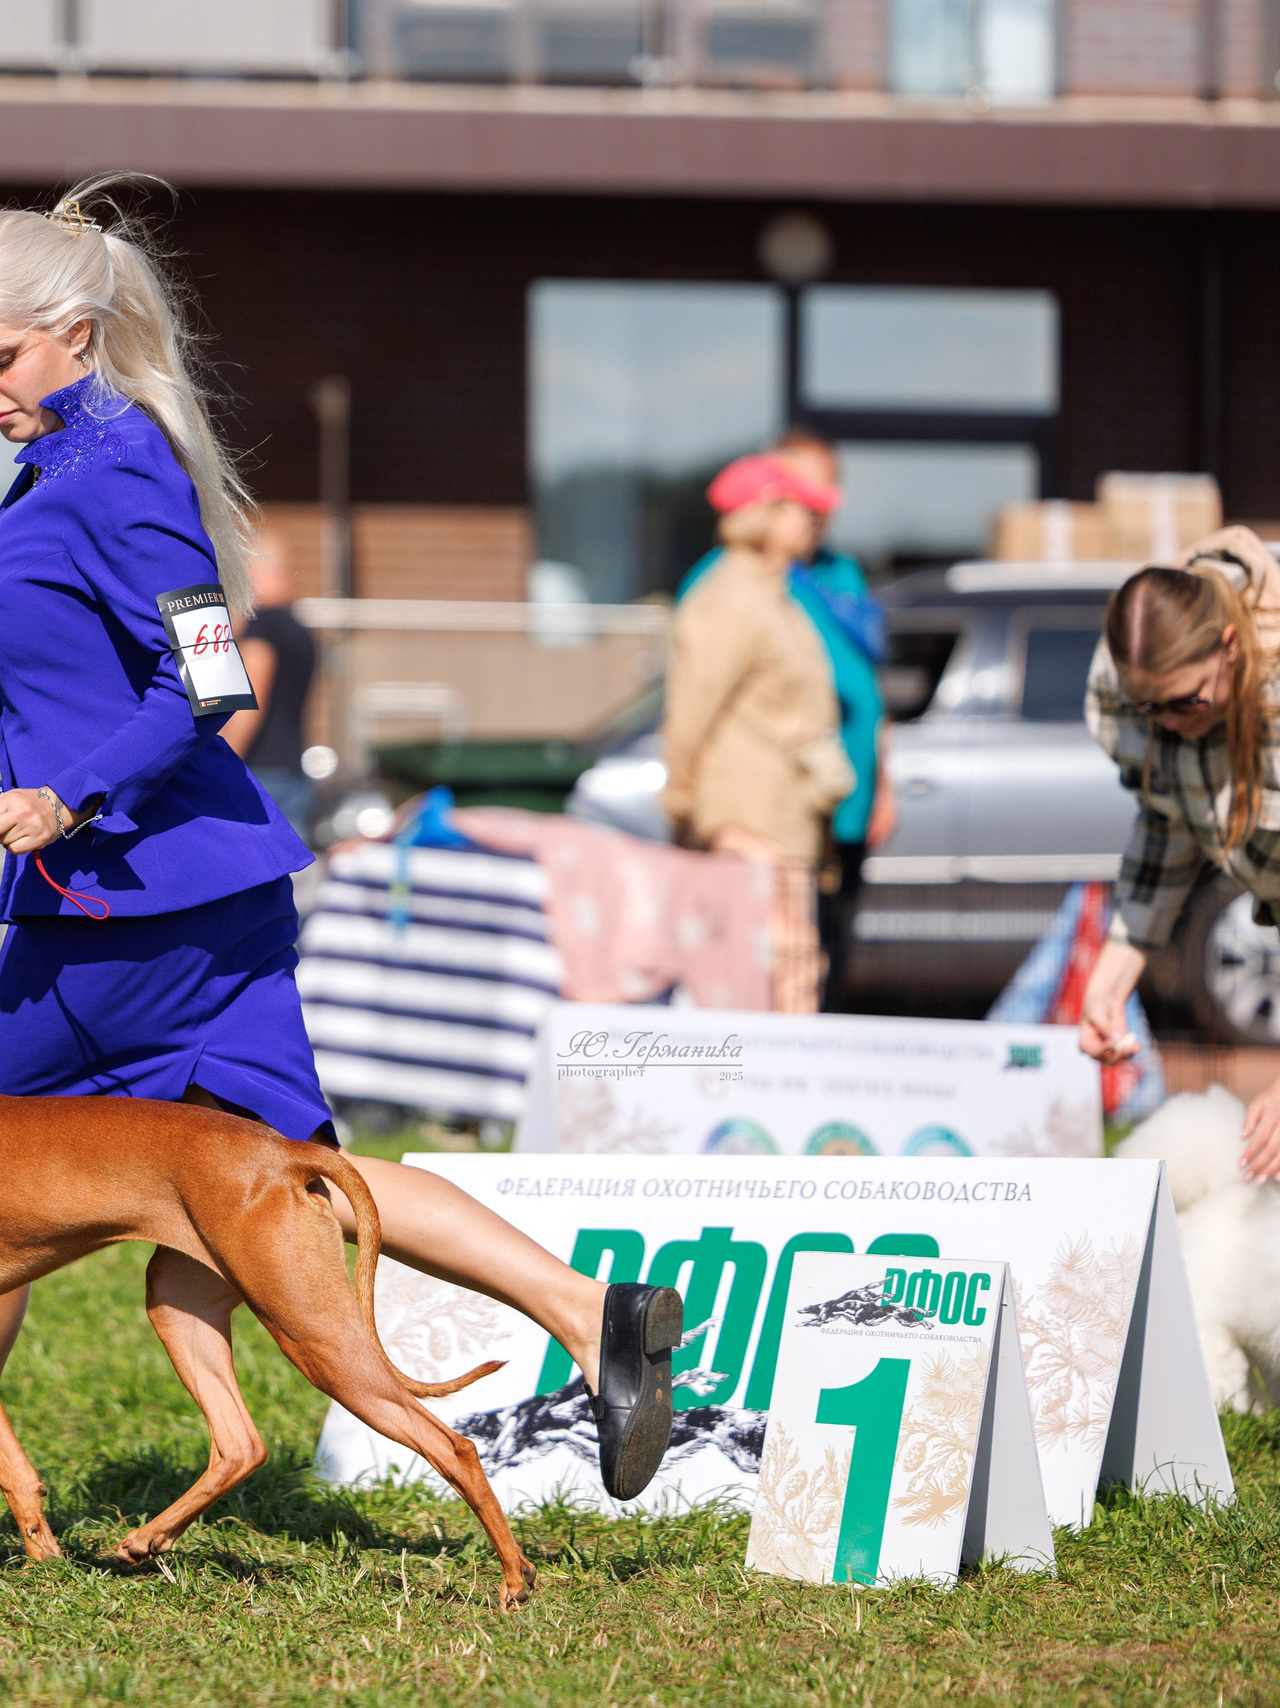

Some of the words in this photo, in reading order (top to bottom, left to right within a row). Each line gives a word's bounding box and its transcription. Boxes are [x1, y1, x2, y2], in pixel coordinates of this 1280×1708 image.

[167, 592, 219, 612] PREMIER
[193, 623, 231, 656] 688
[496, 1177, 637, 1199] ФЕДЕРАЦИЯ
[642, 1178, 817, 1200] ОХОТНИЧЬЕГО
[823, 1180, 1032, 1203] СОБАКОВОДСТВА
[880, 1268, 991, 1327] РФОС
[534, 1226, 940, 1412] РФО
[820, 1327, 864, 1338] ФЕДЕРАЦИЯ
[865, 1329, 919, 1341] ОХОТНИЧЬЕГО
[919, 1332, 982, 1344] СОБАКОВОДСТВА
[815, 1357, 911, 1586] 1
